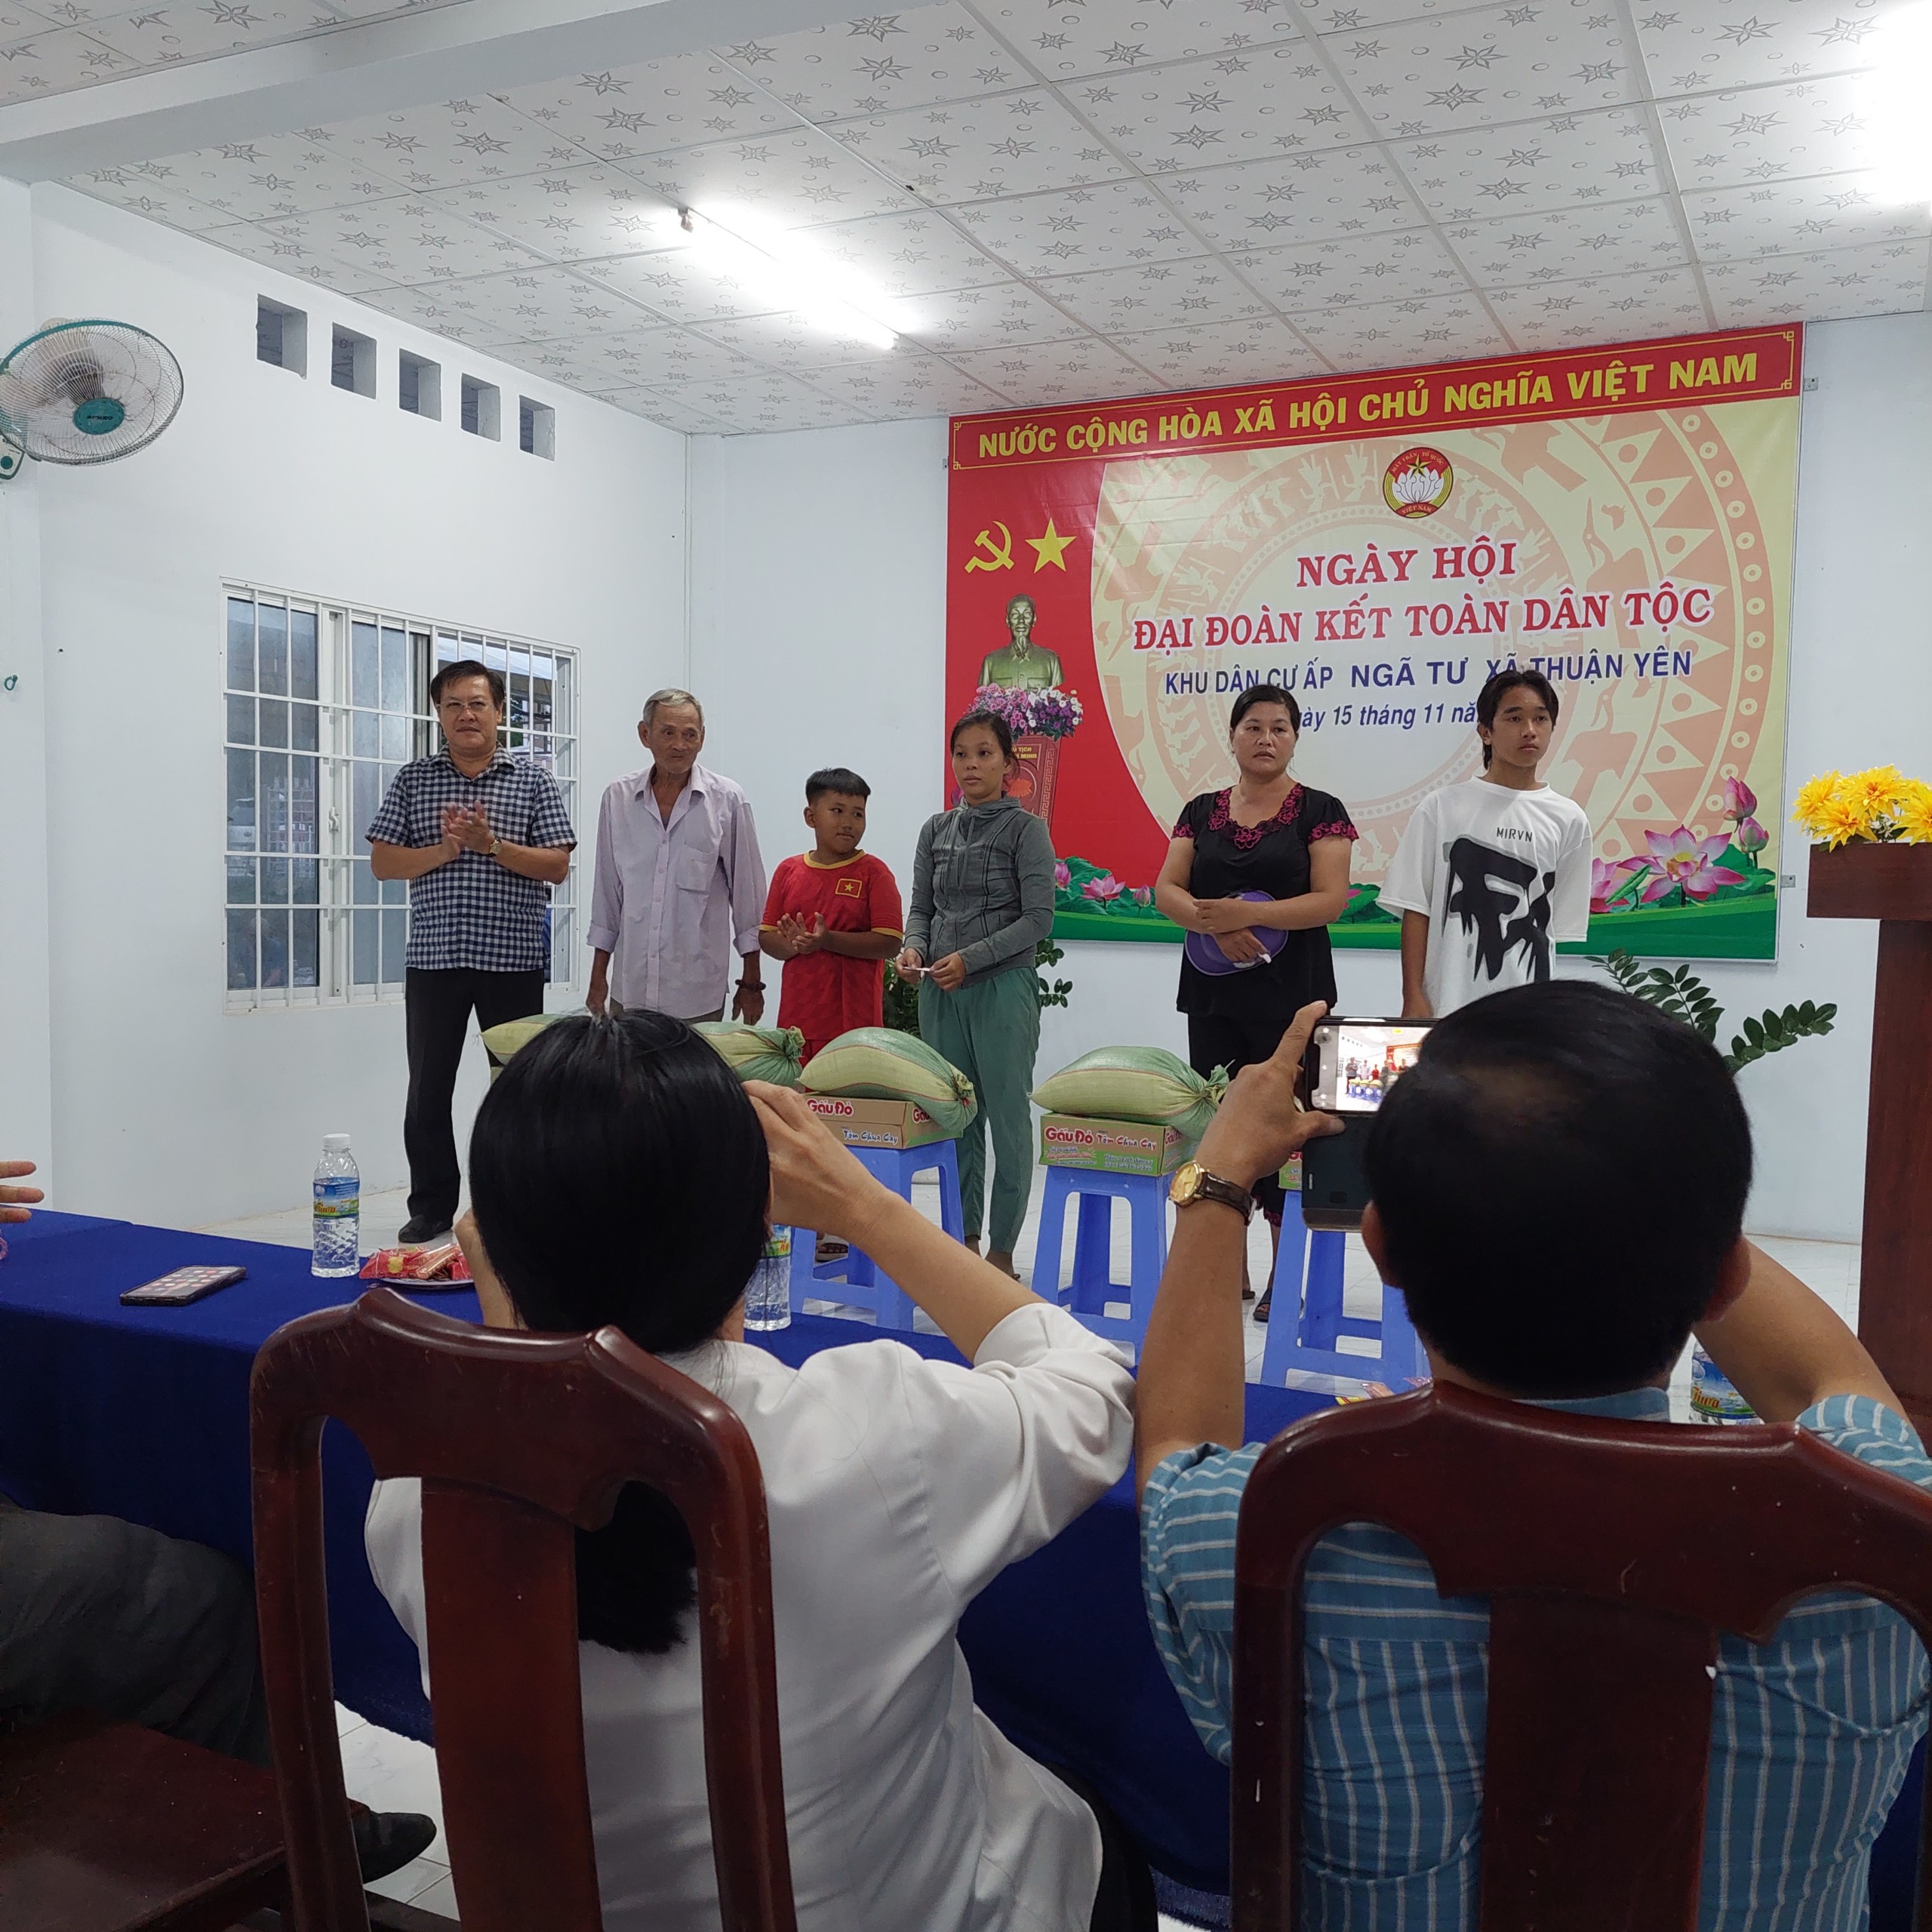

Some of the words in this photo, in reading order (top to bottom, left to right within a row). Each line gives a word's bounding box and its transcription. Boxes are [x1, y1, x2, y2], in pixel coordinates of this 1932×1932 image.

[979, 423, 1057, 457] NƯỚC
[1066, 416, 1148, 453] CỘNG
[1158, 407, 1223, 440] HÒA
[1233, 398, 1275, 434] XÃ
[1289, 392, 1346, 431] HỘI
[1359, 379, 1429, 421] CHỦ
[1444, 370, 1554, 413] NGHĨA
[1567, 361, 1654, 401] VIỆT
[1669, 352, 1757, 389] NAM
[1297, 543, 1419, 588] NGÀY
[1432, 535, 1517, 585] HỘI
[1134, 617, 1194, 656] ĐẠI
[1205, 605, 1303, 647] ĐOÀN
[1315, 593, 1392, 641] KẾT
[1404, 592, 1509, 637] TOÀN
[1523, 586, 1611, 632] DÂN
[1624, 580, 1711, 633] TỘC
[1166, 671, 1208, 695] KHU
[1215, 663, 1260, 693] DÂN
[1266, 664, 1299, 691] CƯ
[1303, 657, 1334, 690] ẤP
[1351, 657, 1416, 688] NGÃ
[1426, 657, 1469, 685] TƯ
[1529, 648, 1623, 685] THUẬN
[1633, 645, 1692, 678] YÊN
[1333, 704, 1353, 726] 15
[1359, 703, 1417, 730] tháng
[1424, 703, 1444, 724] 11
[1451, 701, 1476, 723] nă
[883, 1133, 898, 1145] Cay
[1097, 1134, 1114, 1144] Tôm
[1140, 1139, 1157, 1151] Cay
